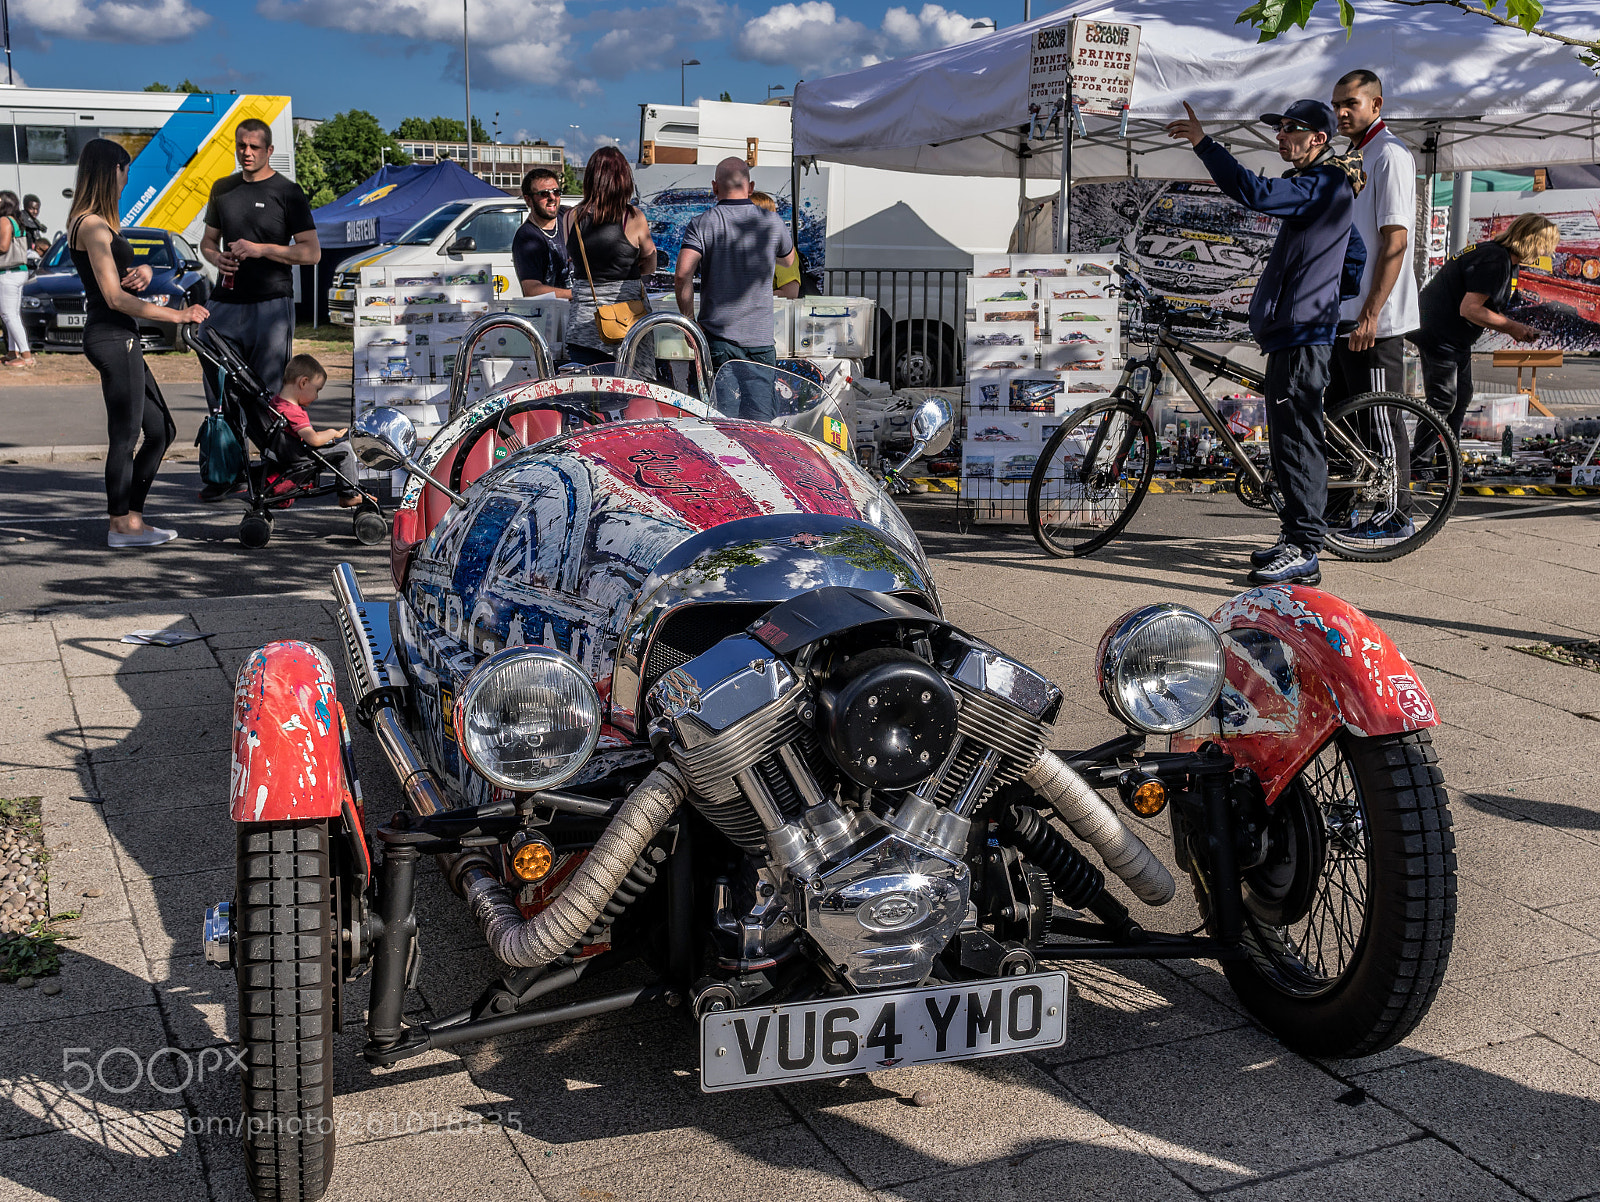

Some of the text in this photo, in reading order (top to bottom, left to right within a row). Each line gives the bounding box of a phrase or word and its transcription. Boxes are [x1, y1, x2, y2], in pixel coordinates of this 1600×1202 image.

[1086, 34, 1129, 46] COLOUR
[1033, 54, 1067, 66] PRINTS
[1078, 48, 1132, 62] PRINTS
[1077, 59, 1131, 71] 25.00 EACH
[1101, 77, 1129, 86] OFFER
[1082, 83, 1102, 91] FOR
[1106, 86, 1129, 94] 40.00
[346, 217, 376, 242] BILSTEIN
[68, 316, 80, 325] D3
[831, 431, 842, 445] 15
[1405, 689, 1428, 716] 3
[734, 984, 1043, 1075] VU64 YMO
